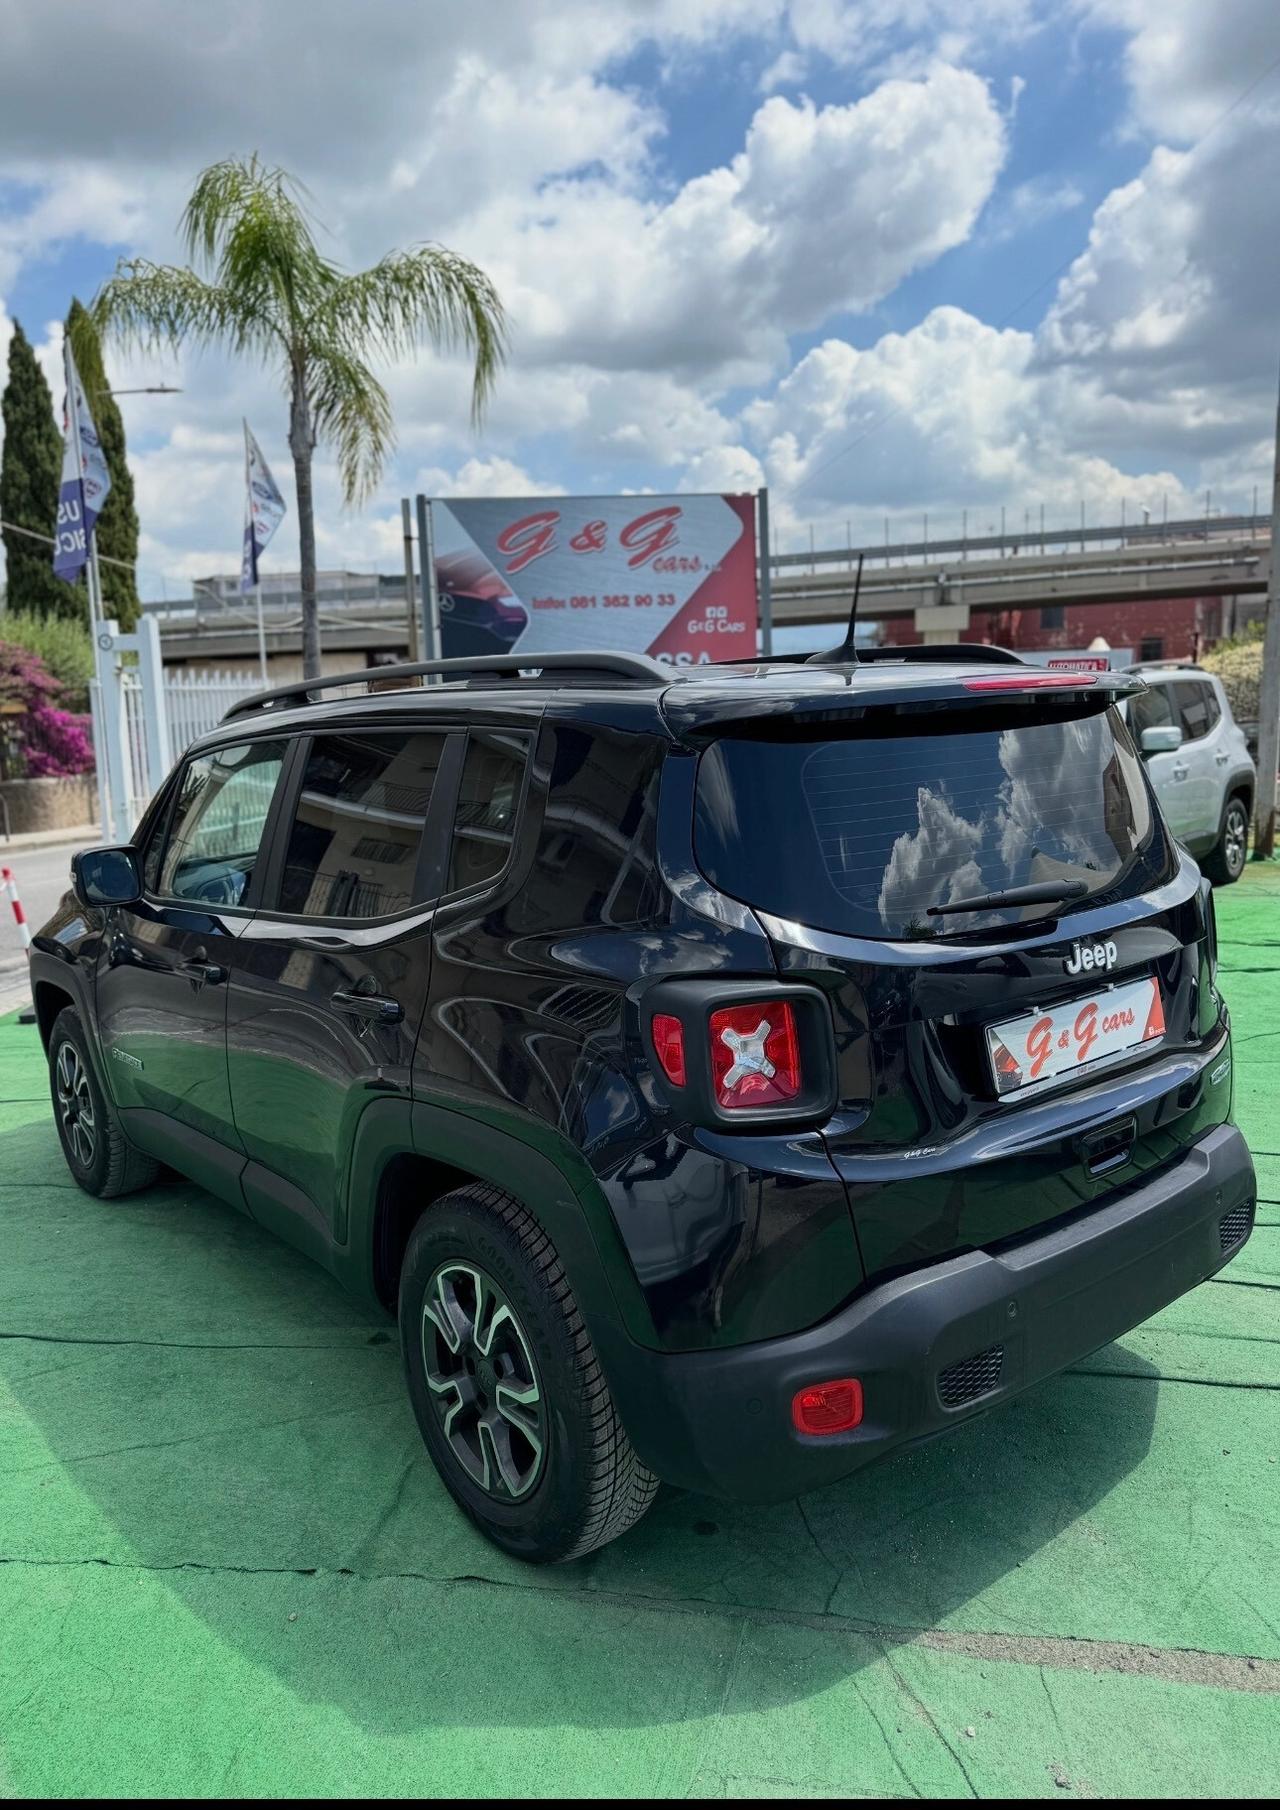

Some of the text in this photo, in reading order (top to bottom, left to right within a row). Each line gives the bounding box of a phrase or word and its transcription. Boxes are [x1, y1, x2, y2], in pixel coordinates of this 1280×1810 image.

[497, 511, 560, 574] G
[569, 520, 608, 554] &
[619, 506, 682, 570] G
[570, 595, 597, 609] 081
[634, 593, 653, 607] 90
[657, 593, 675, 607] 33
[1066, 941, 1117, 974] Jeep
[1026, 1002, 1136, 1079] G & G cars
